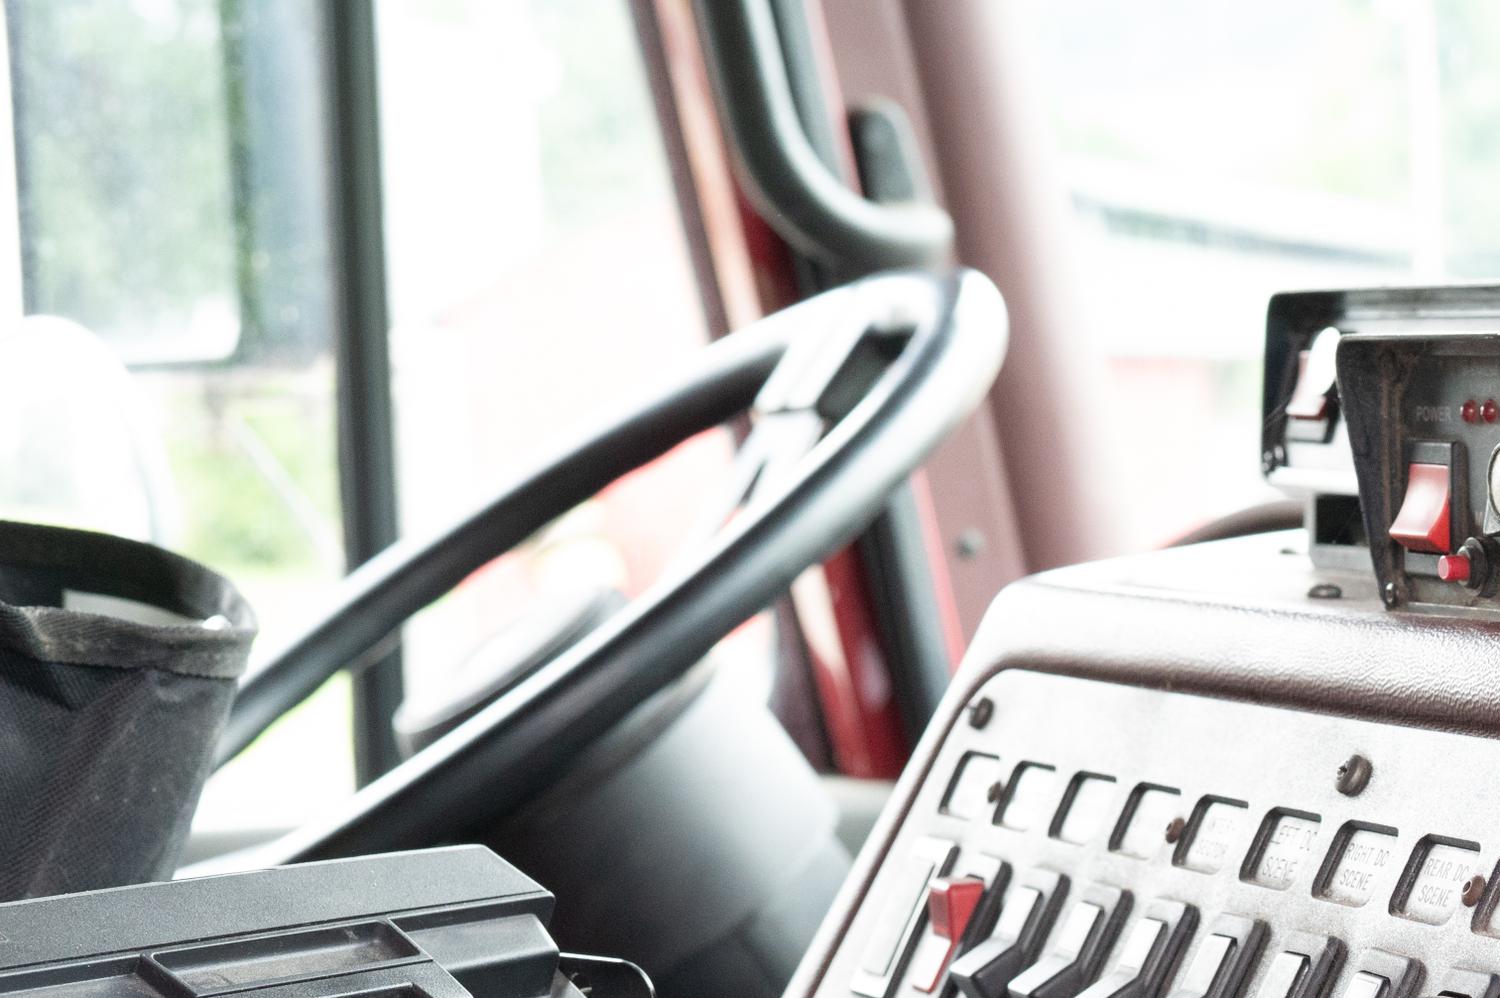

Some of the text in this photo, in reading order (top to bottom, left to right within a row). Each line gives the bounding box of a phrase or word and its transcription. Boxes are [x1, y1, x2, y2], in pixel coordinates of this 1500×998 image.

[1416, 406, 1452, 422] POWER
[1345, 842, 1391, 868] RIGHT DC
[1339, 868, 1374, 892] SCENE
[1425, 857, 1470, 883] REAR DC
[1417, 884, 1453, 908] SCENE
